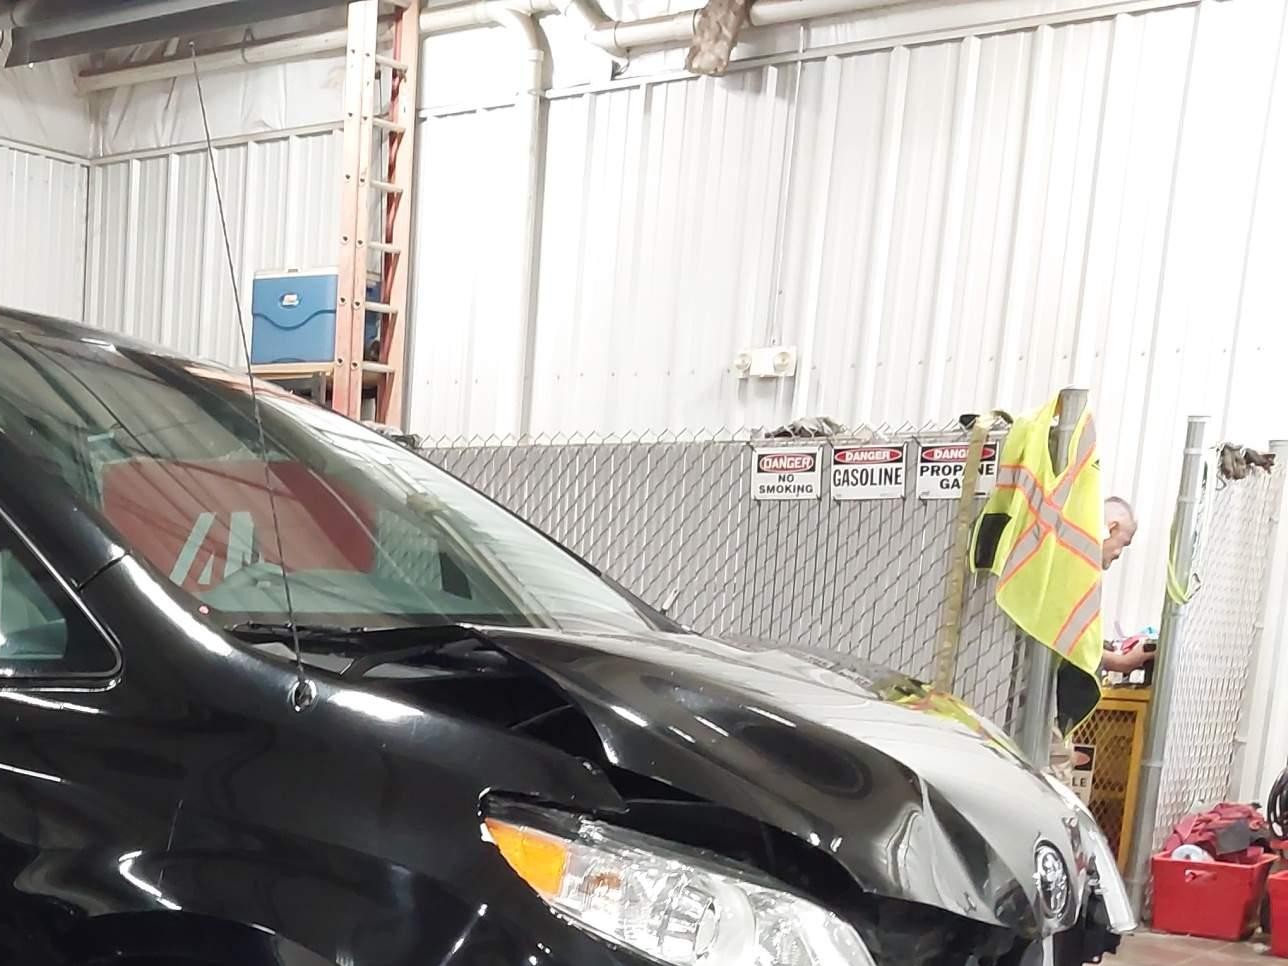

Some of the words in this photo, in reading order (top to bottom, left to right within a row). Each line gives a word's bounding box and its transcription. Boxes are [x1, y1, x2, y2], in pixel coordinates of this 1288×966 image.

[845, 451, 890, 462] DANGER
[934, 448, 969, 459] DANG
[764, 457, 810, 470] DANGER
[778, 474, 794, 483] NO
[833, 467, 902, 487] GASOLINE
[759, 484, 813, 494] SMOKING
[939, 478, 961, 490] GA
